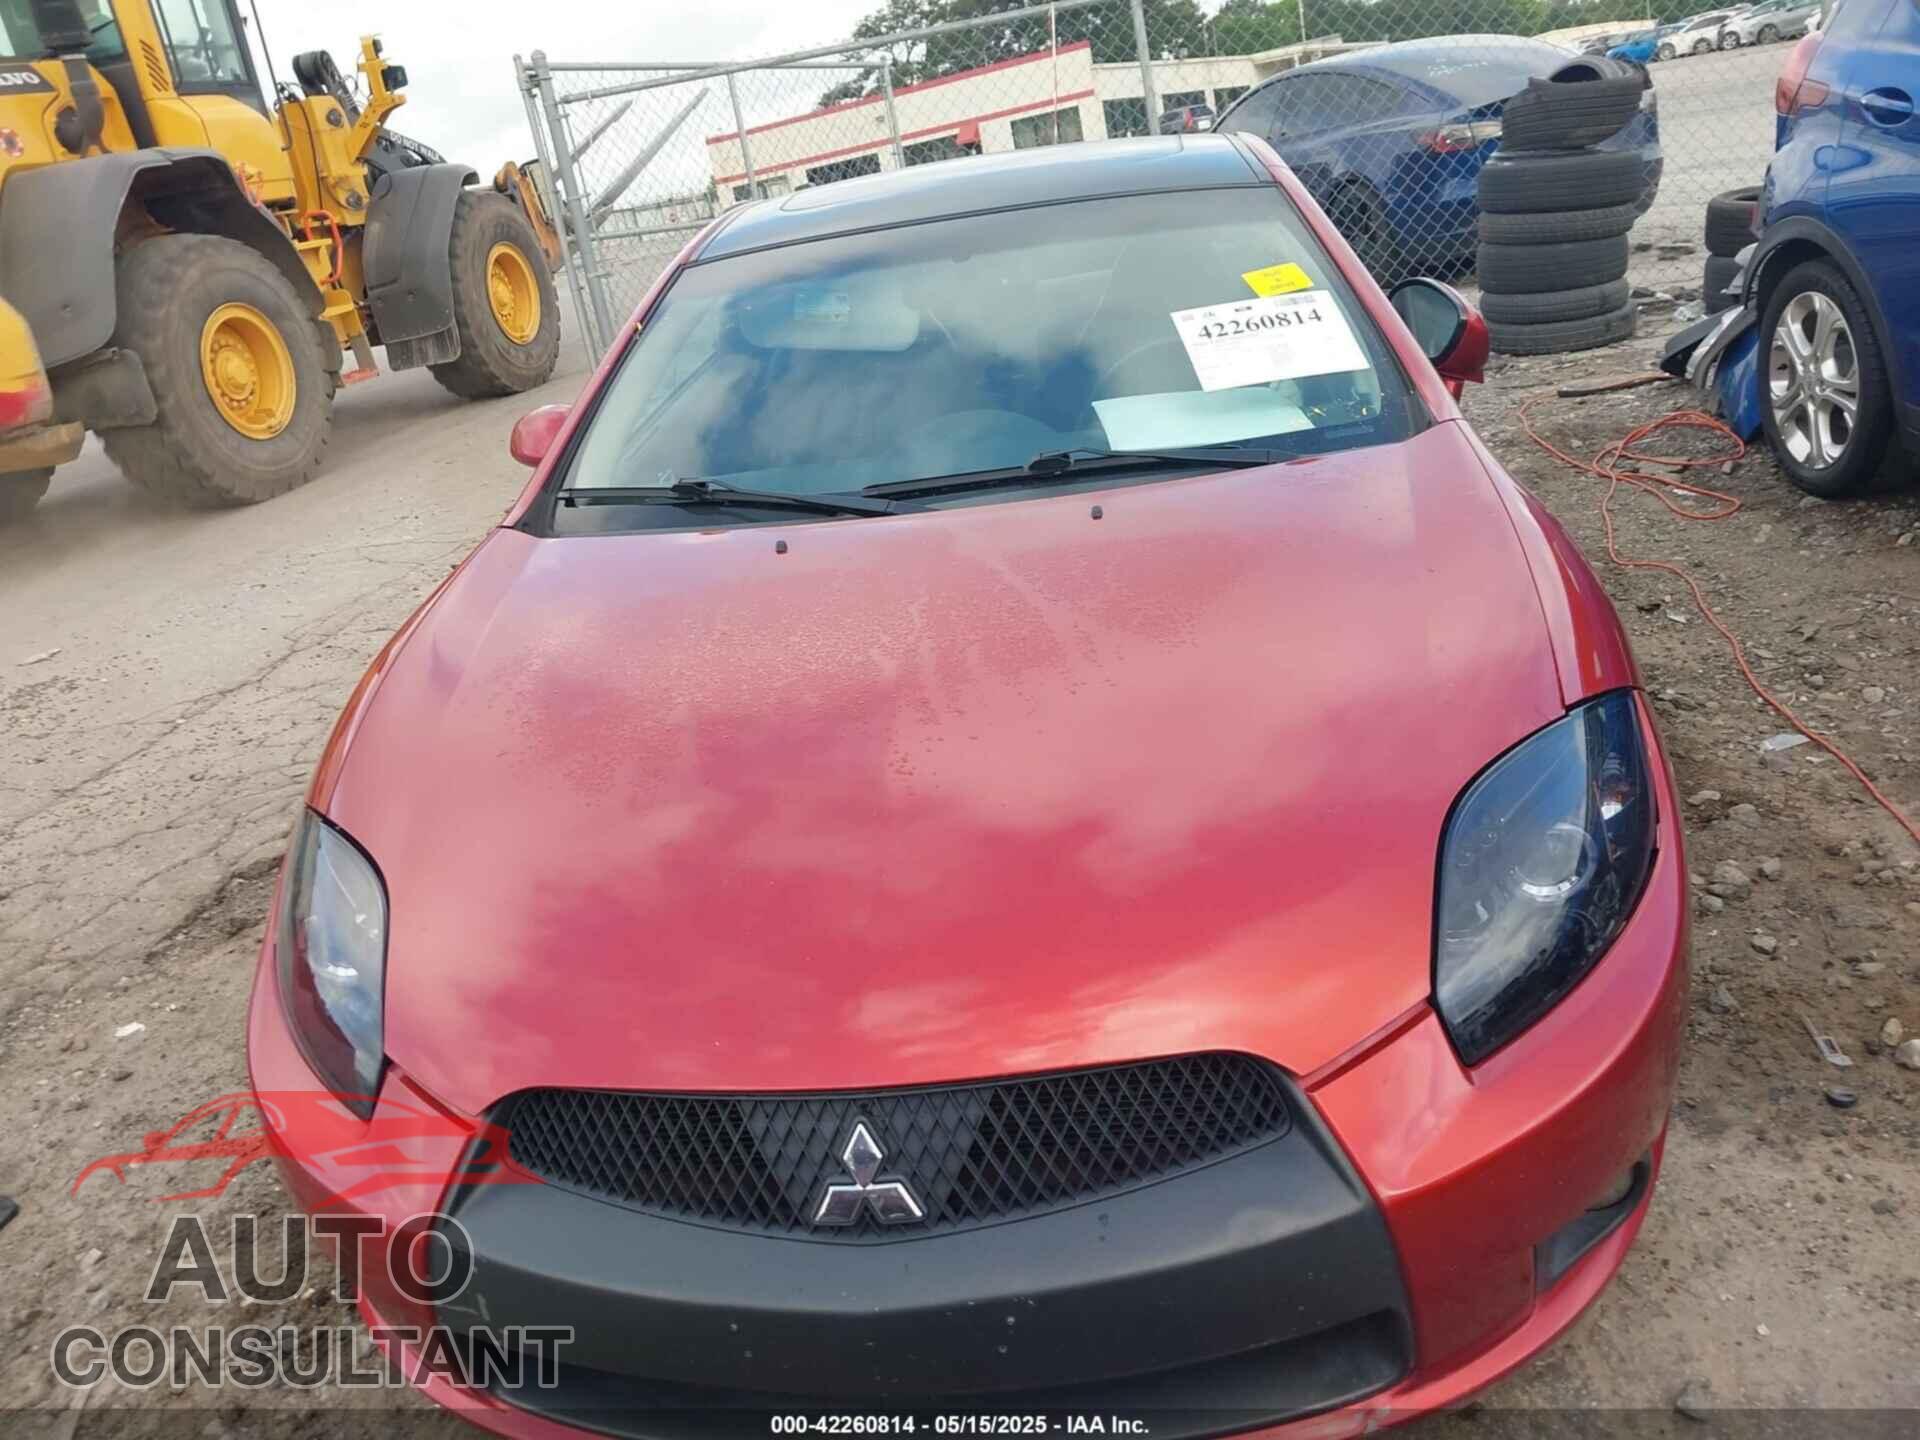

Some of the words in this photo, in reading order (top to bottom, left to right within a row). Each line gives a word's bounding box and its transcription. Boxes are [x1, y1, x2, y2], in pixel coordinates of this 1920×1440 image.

[389, 131, 402, 144] DO
[403, 137, 419, 151] NOT
[1198, 307, 1323, 340] 42260814
